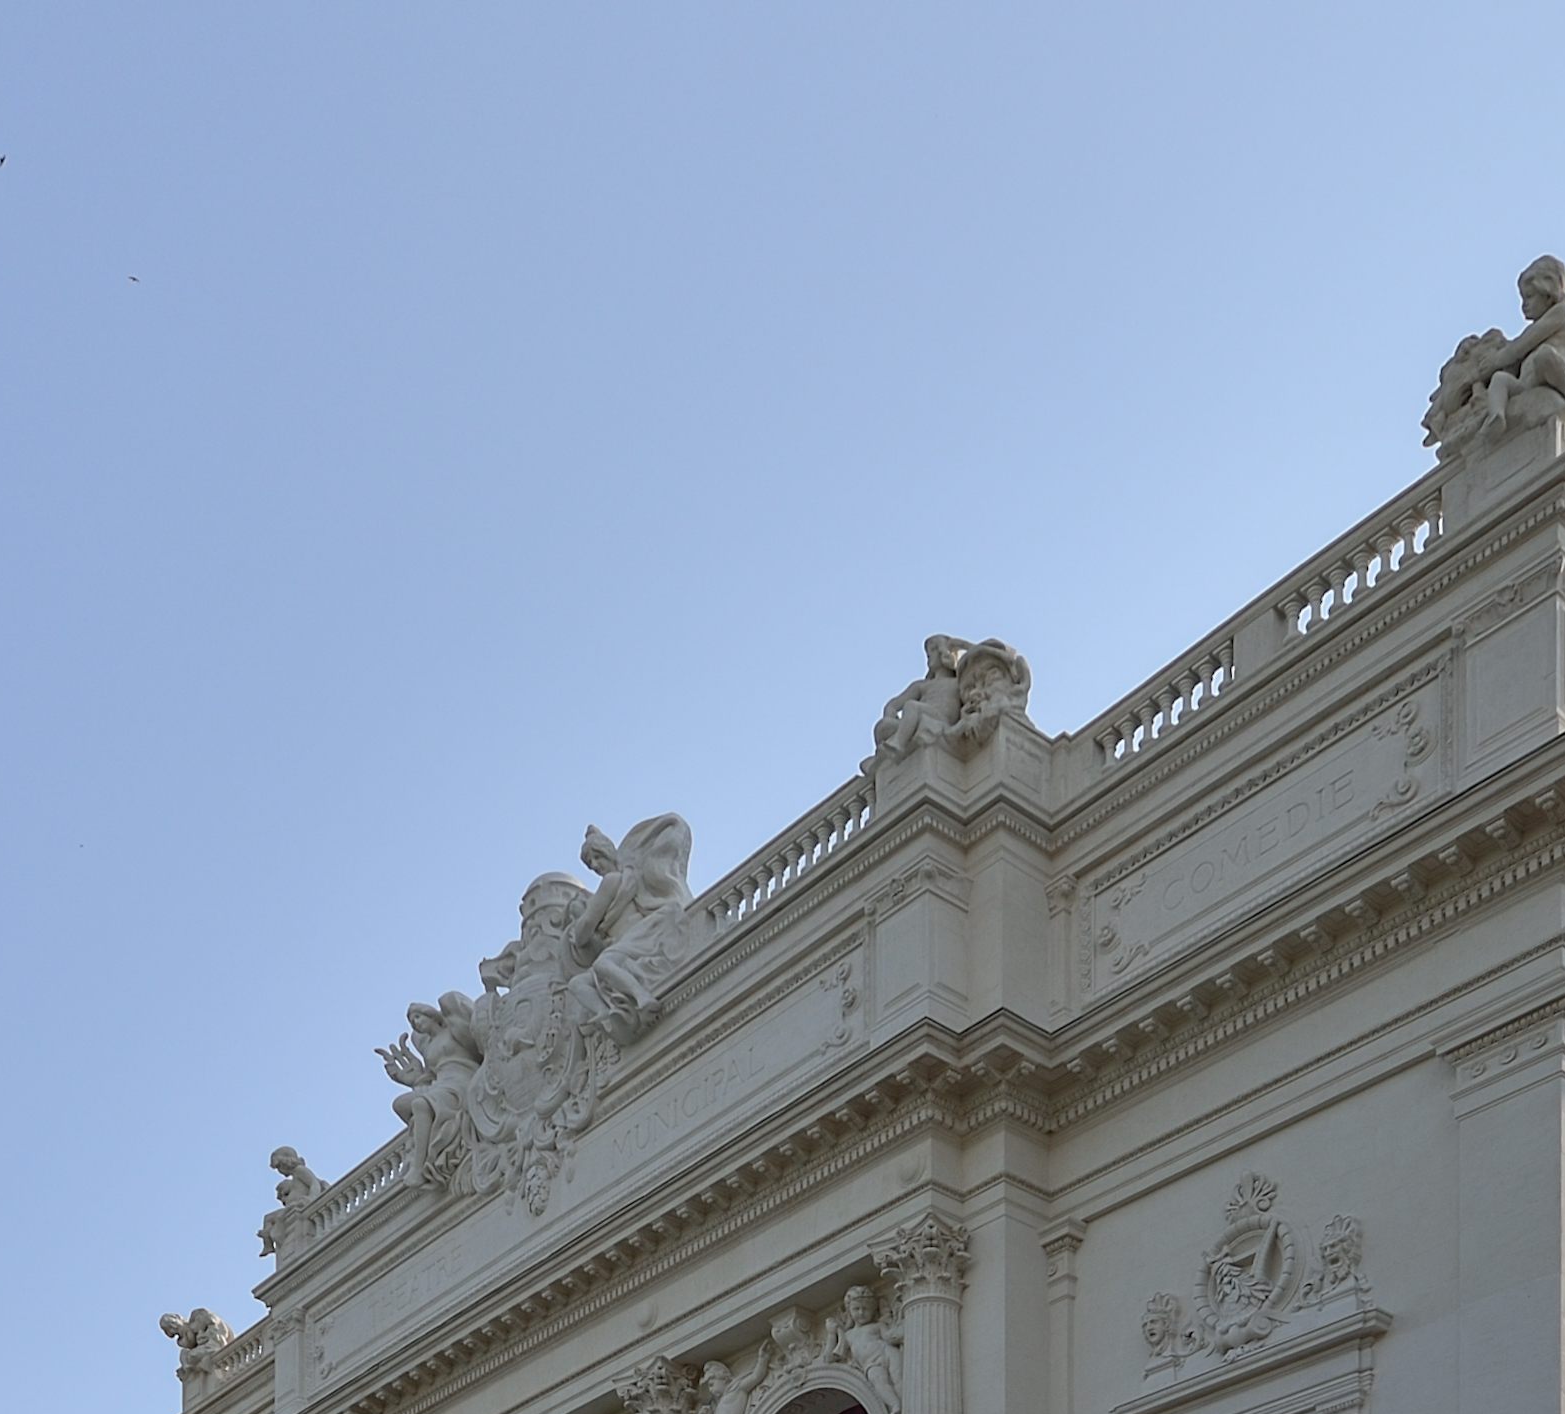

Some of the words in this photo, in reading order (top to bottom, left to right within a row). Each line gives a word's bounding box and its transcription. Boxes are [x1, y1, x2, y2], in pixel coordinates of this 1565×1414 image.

[1162, 769, 1356, 911] COMEDIE
[609, 1046, 768, 1171] MUNICIPAL
[367, 1244, 464, 1330] THEATRE
